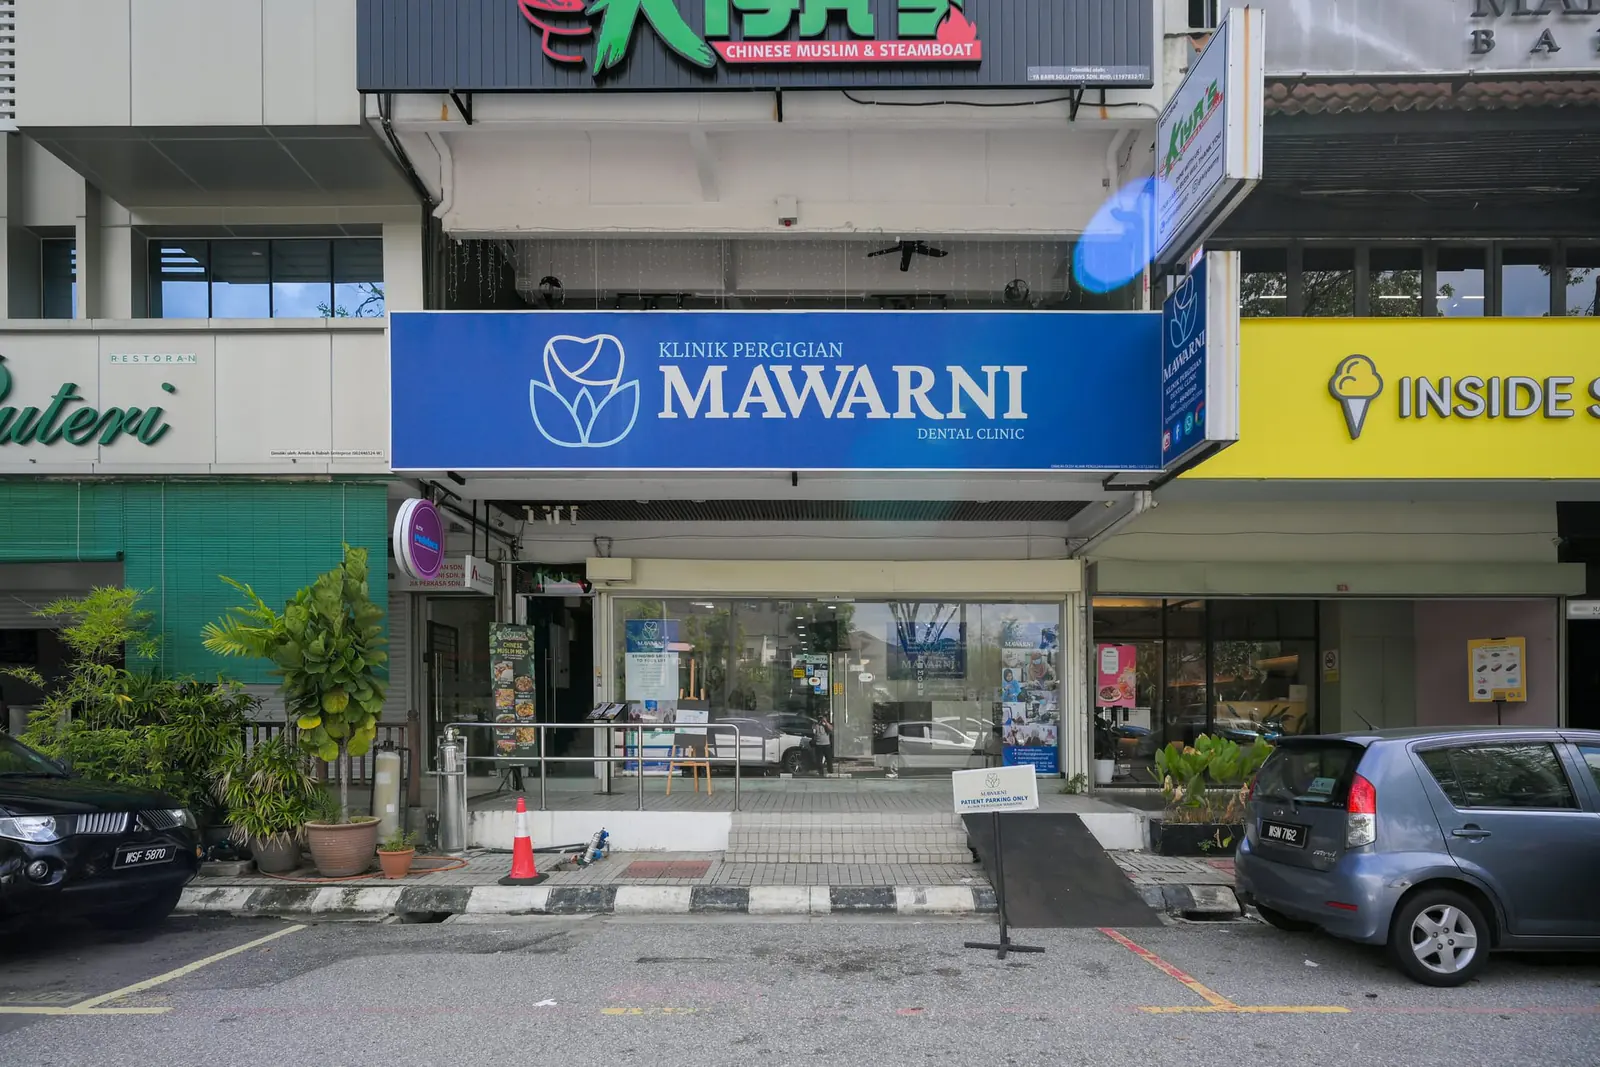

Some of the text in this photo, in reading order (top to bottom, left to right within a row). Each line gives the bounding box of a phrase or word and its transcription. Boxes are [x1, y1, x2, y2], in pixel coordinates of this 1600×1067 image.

[726, 43, 973, 58] CHINESE MUSLIM & STEAMBOAT
[659, 342, 843, 358] KLINIK PERGIGIAN
[1163, 330, 1205, 383] MAWARNI
[0, 354, 176, 446] uteri
[658, 364, 1028, 420] MAWARNI
[1398, 376, 1575, 418] INSIDE
[918, 428, 1024, 440] DENTAL CLINIC
[1268, 825, 1297, 841] WSN 7162
[125, 848, 166, 863] WSF 5870
